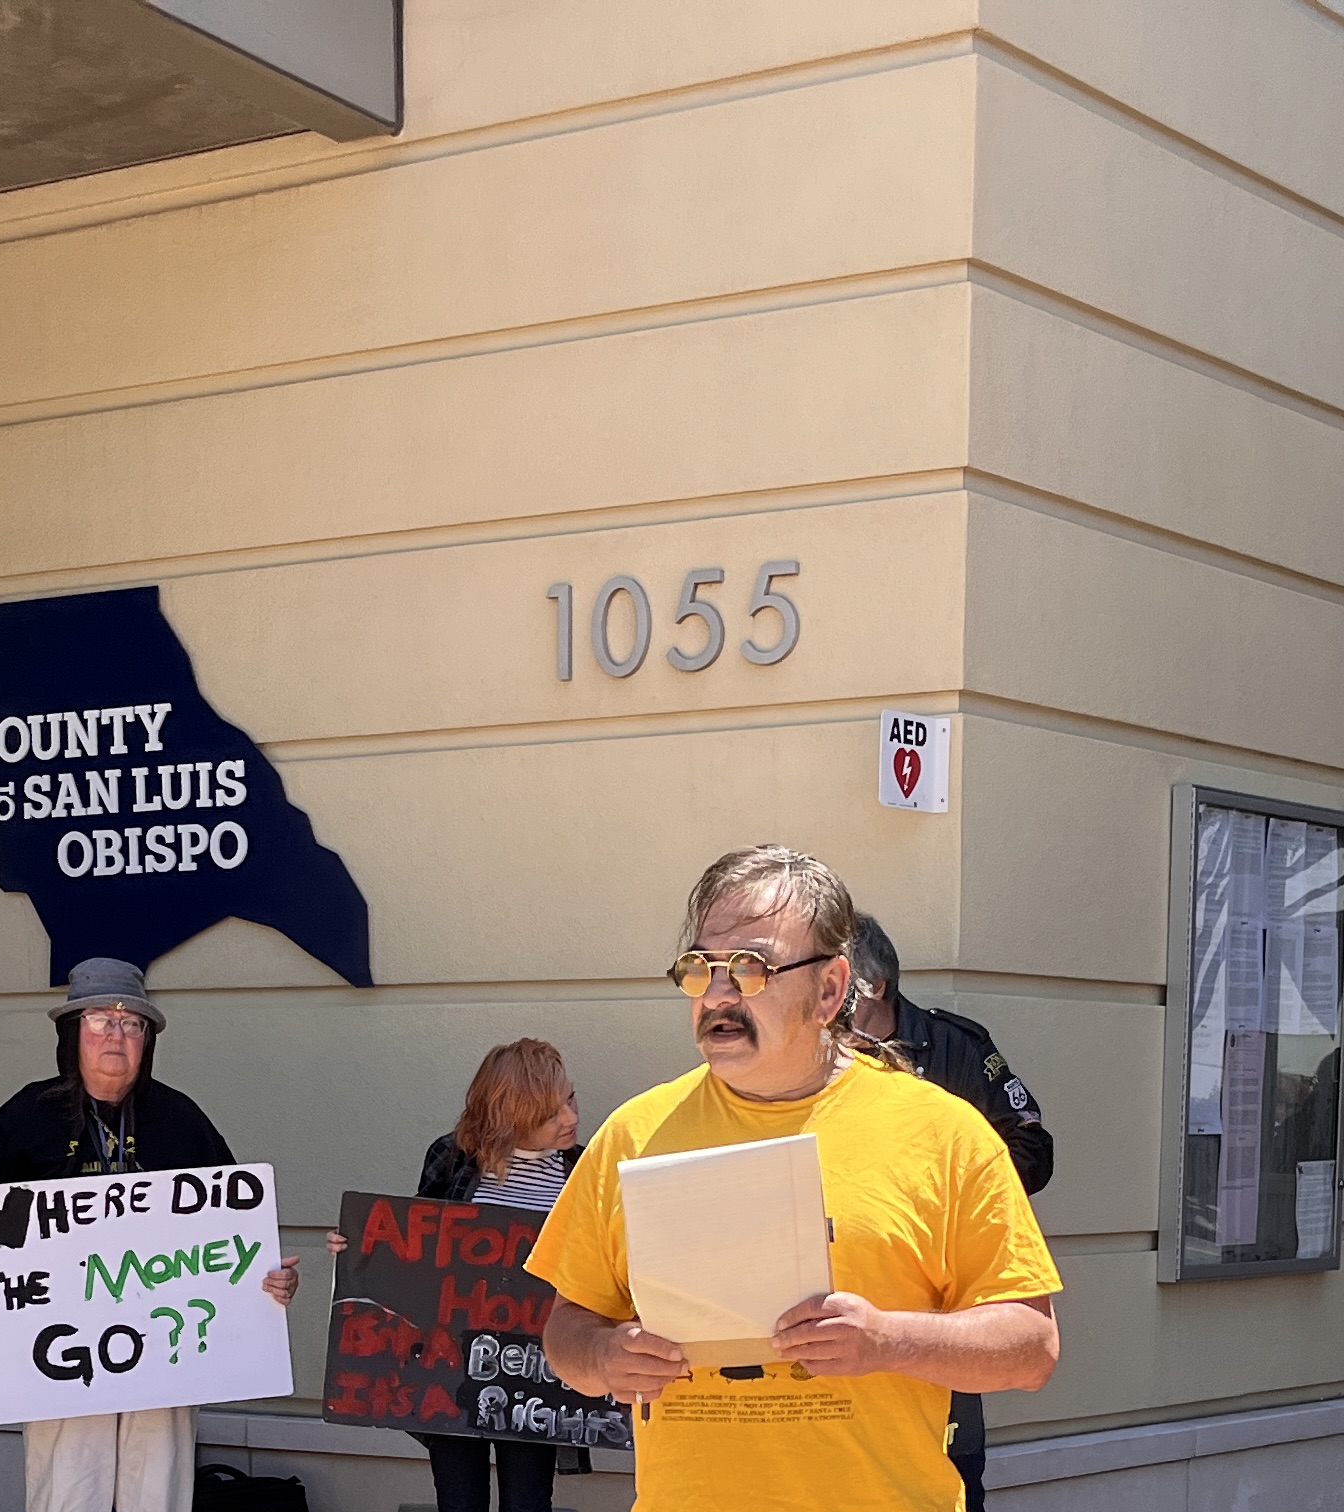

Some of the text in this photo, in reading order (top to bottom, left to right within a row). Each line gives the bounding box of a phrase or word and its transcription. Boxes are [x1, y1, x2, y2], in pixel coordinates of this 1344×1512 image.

[546, 560, 800, 682] 1055
[889, 717, 928, 748] AED
[24, 769, 122, 820] SAN
[132, 760, 248, 812] LUIS
[57, 820, 249, 878] OBISPO
